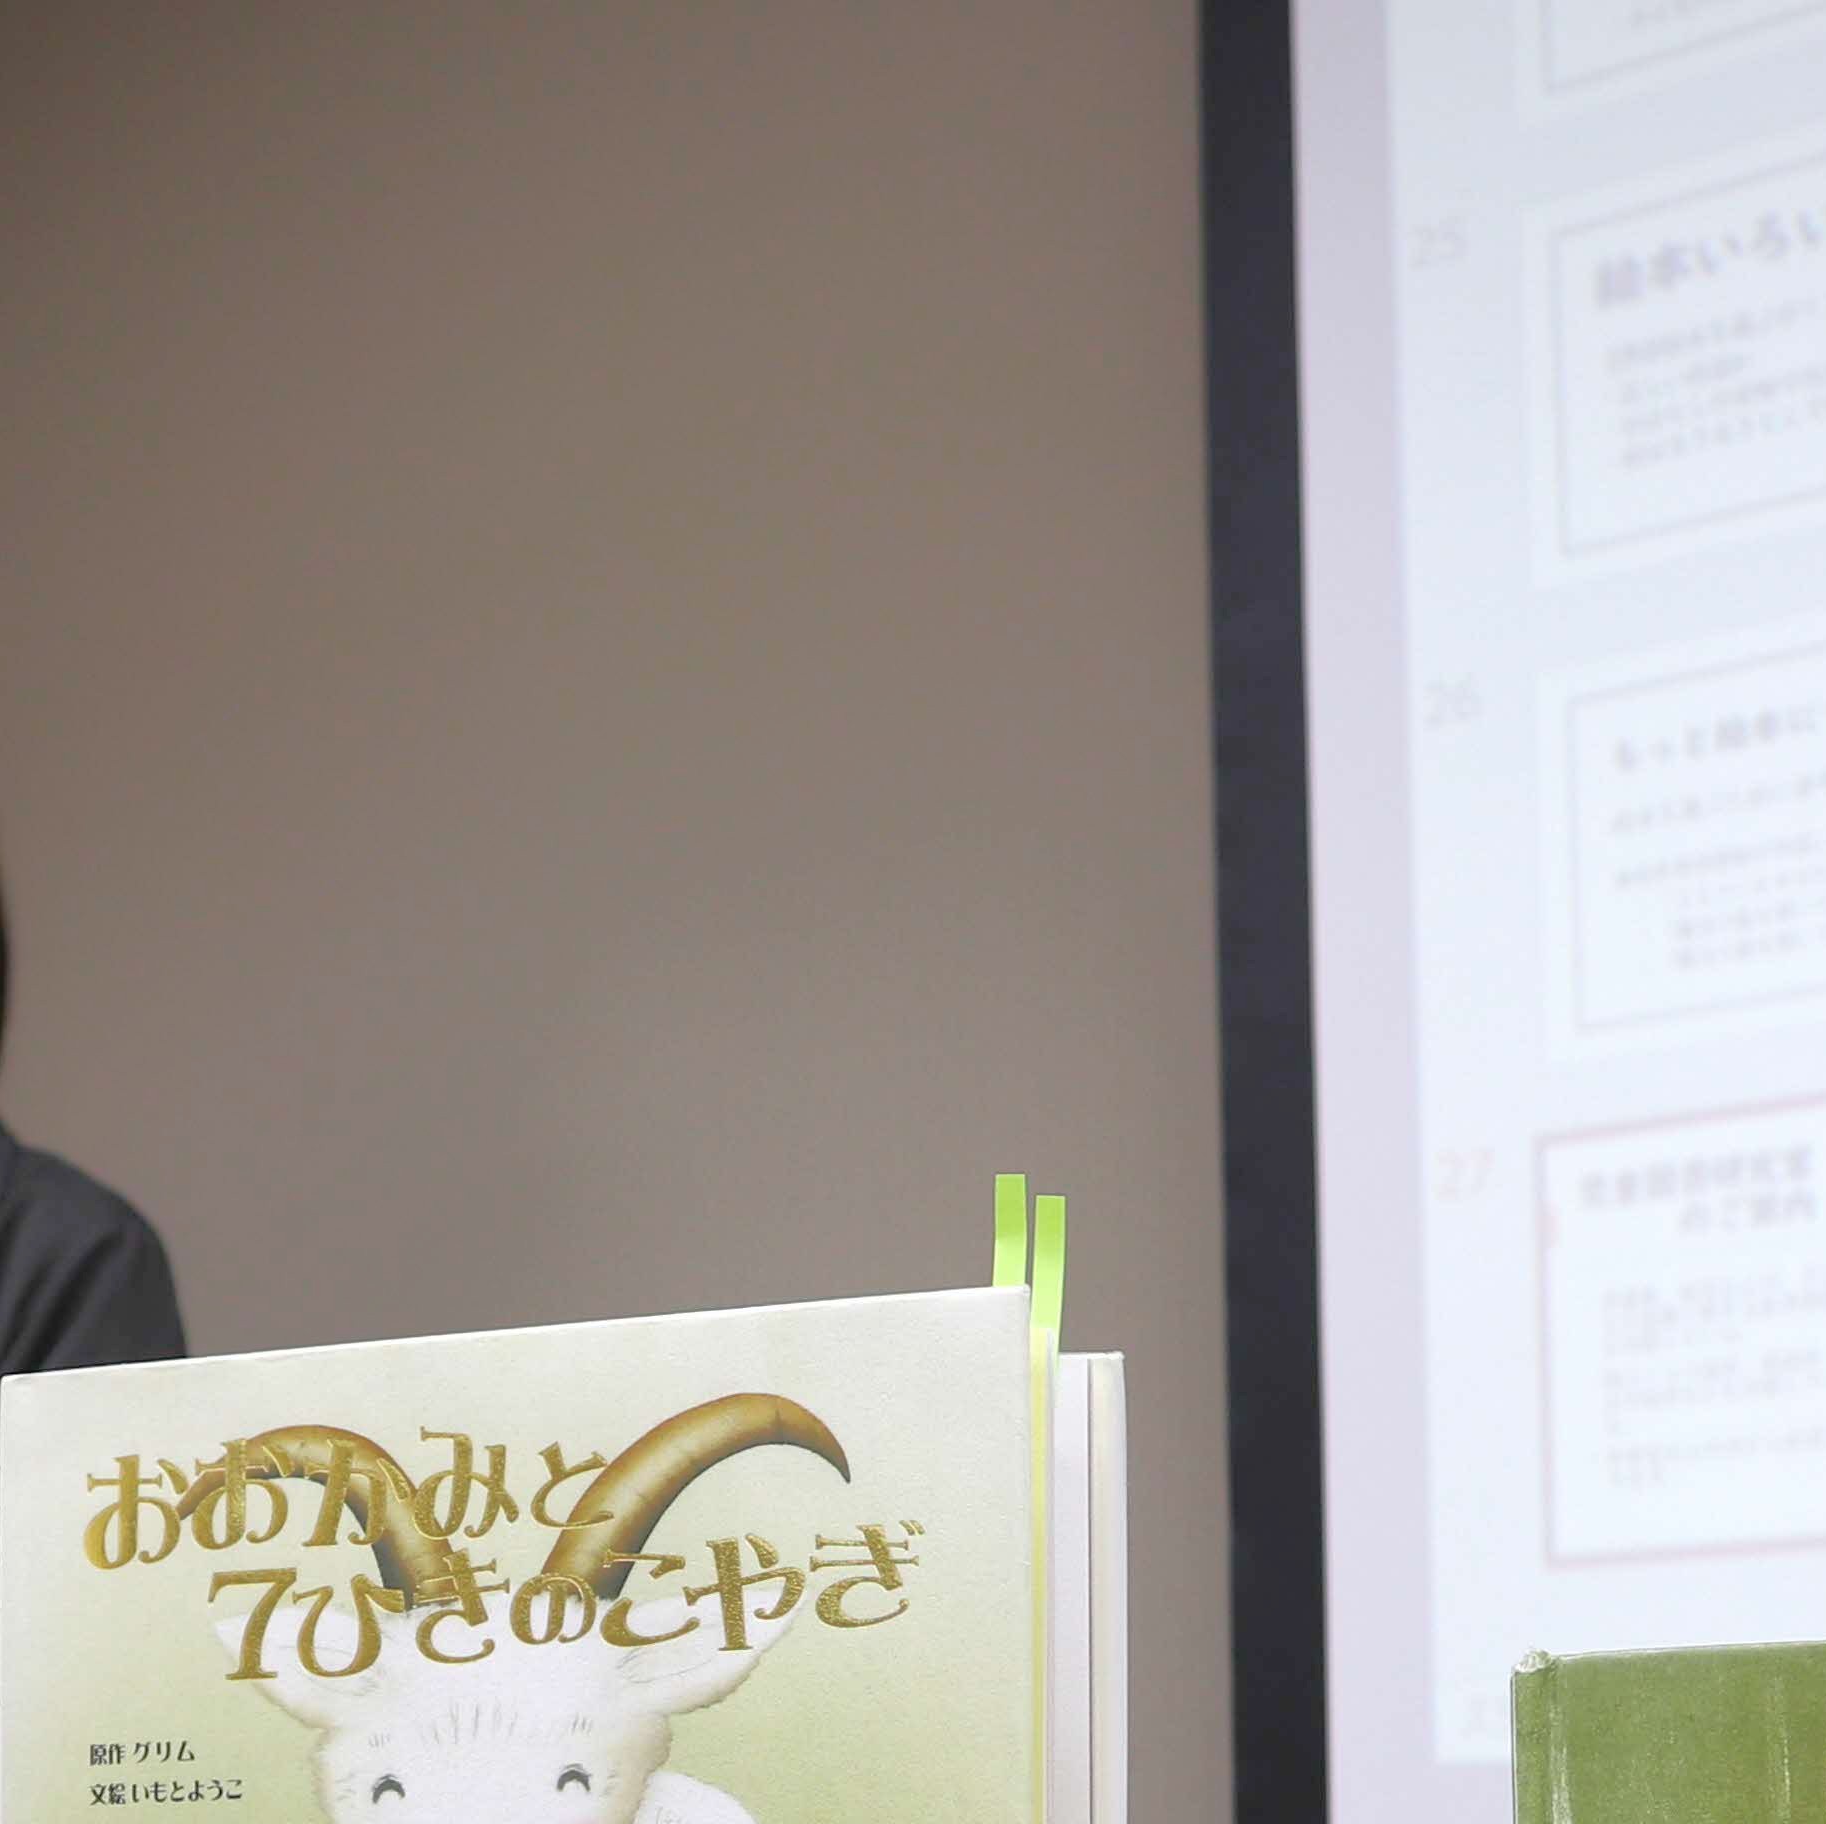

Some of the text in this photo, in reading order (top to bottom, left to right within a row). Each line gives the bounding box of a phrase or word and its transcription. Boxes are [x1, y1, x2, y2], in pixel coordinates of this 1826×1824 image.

[1409, 215, 1469, 270] 25
[1423, 671, 1482, 730] 26
[1435, 1145, 1495, 1203] 27
[82, 1425, 616, 1573] おおかみと
[207, 1518, 923, 1682] 7ひきのこやぎ
[89, 1740, 195, 1766] 原作 グリム
[90, 1779, 244, 1805] 文絵 いもとようこ
